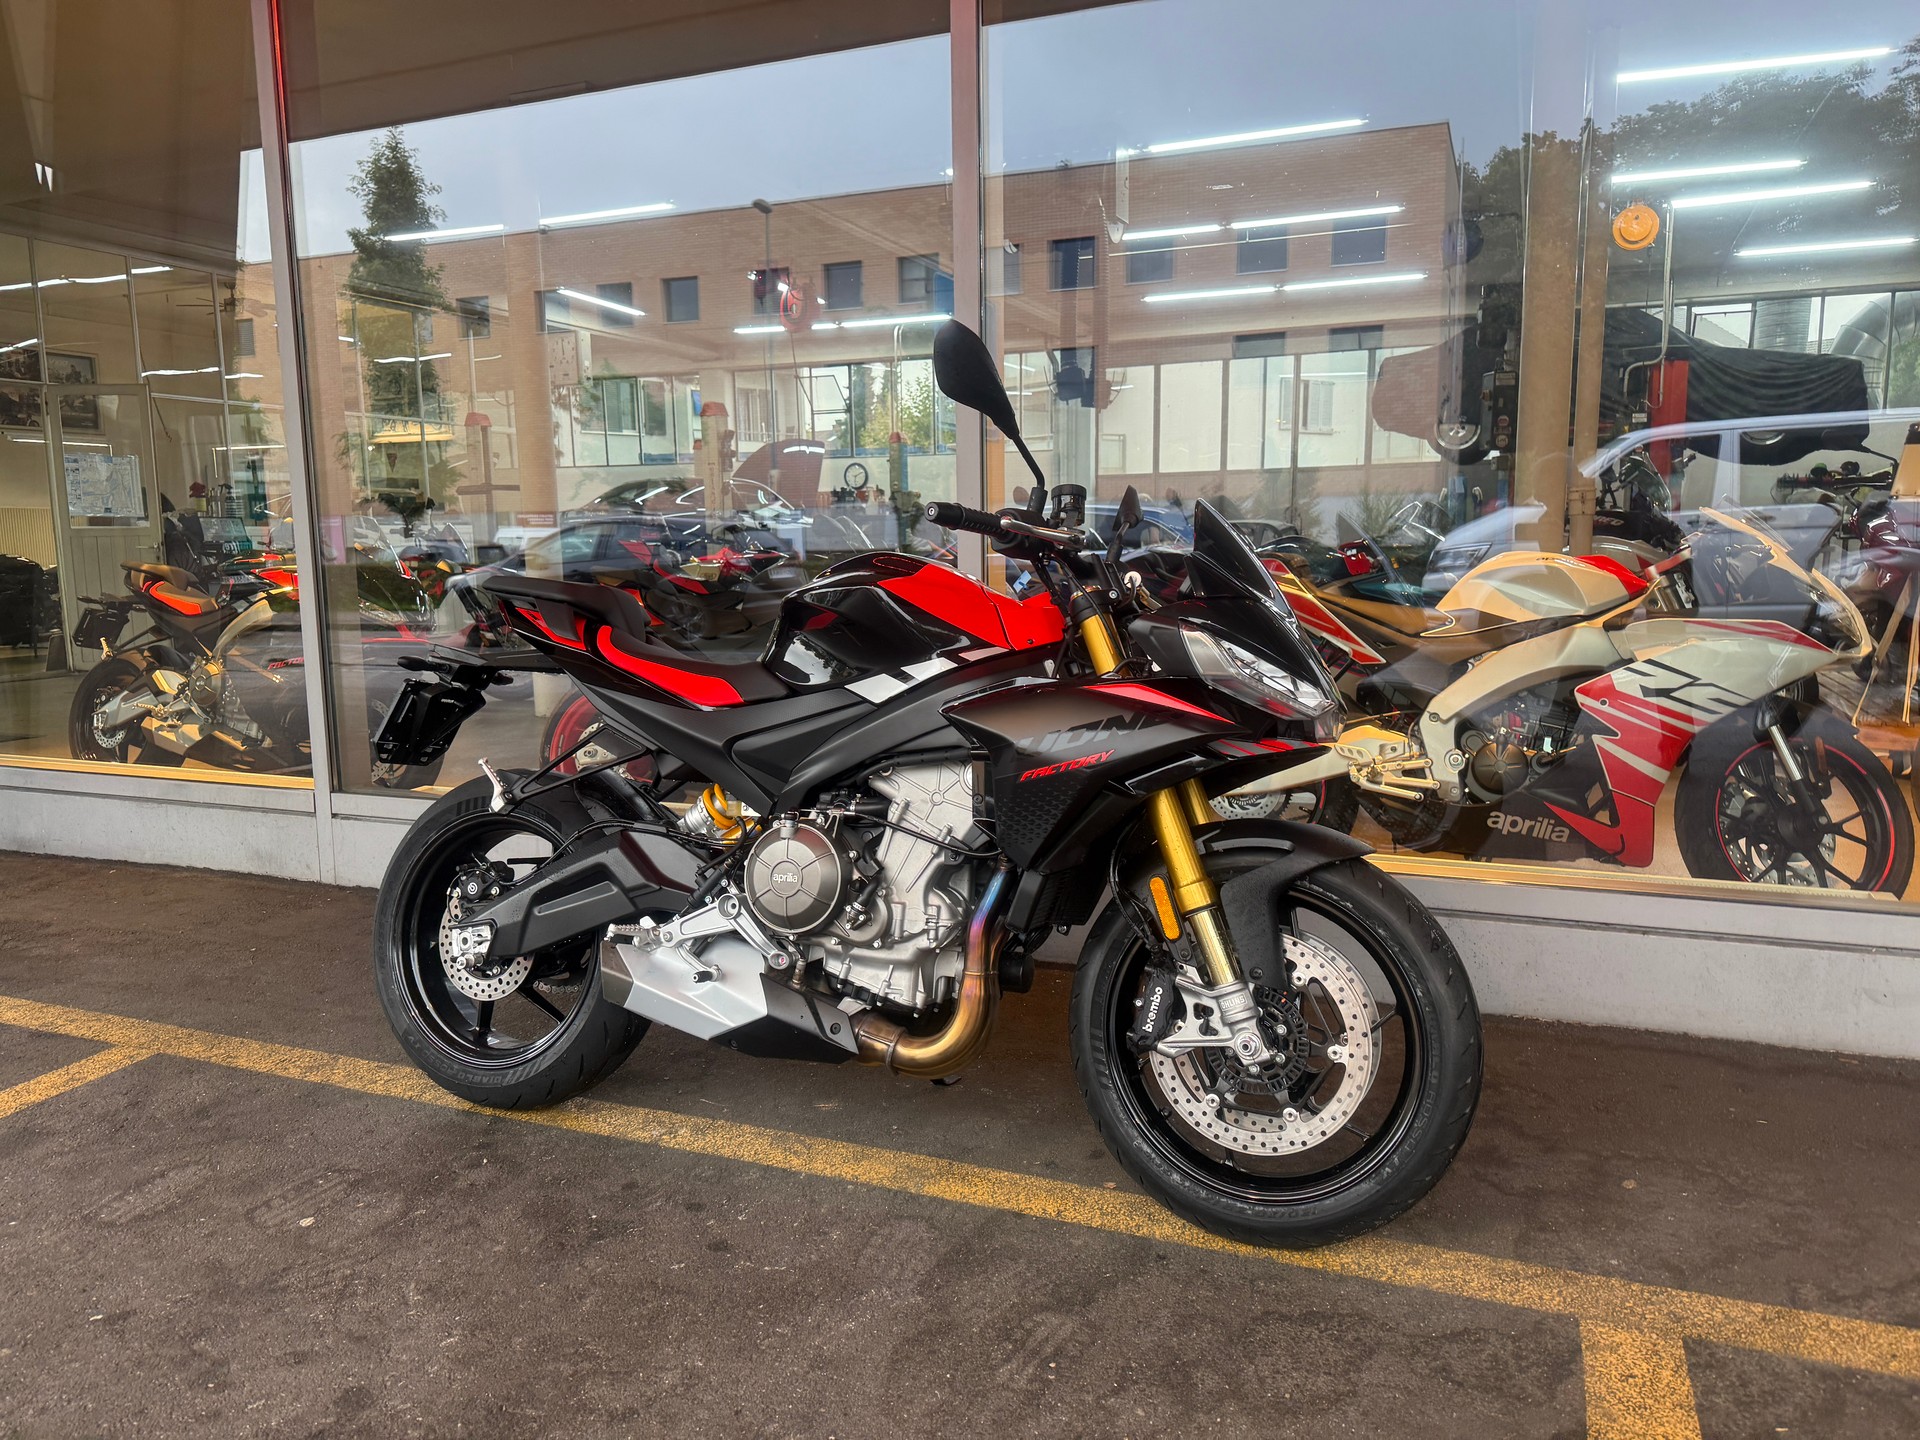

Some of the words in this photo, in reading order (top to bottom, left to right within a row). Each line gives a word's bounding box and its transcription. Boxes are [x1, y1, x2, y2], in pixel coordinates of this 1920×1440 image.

[1020, 748, 1116, 782] FACTORY
[1486, 811, 1570, 843] aprilia
[772, 872, 799, 884] aprilia
[1142, 986, 1163, 1033] brembo
